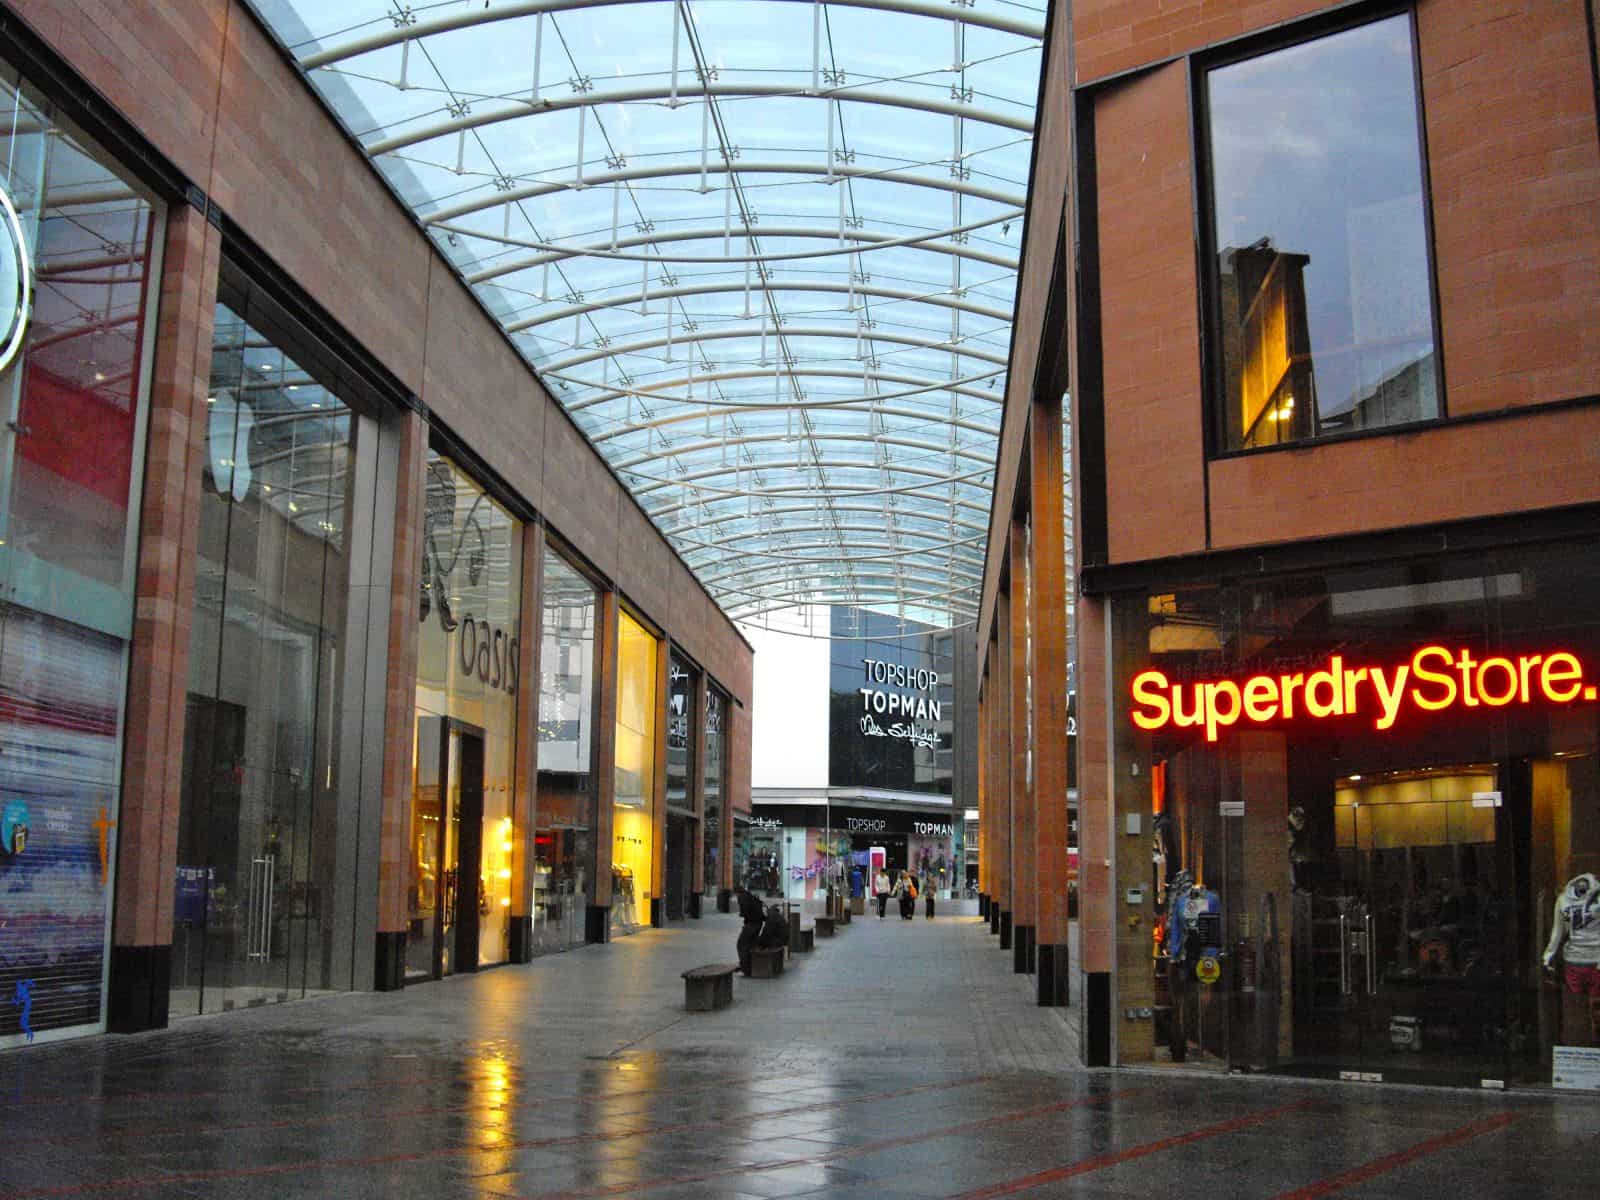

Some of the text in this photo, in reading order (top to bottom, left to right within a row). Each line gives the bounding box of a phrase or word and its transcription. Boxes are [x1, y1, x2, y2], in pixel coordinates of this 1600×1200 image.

[461, 613, 518, 696] oasis
[863, 658, 938, 692] TOPSHOP
[860, 688, 941, 721] TOPMAN
[887, 722, 942, 751] Selfridge
[846, 817, 887, 832] TOPSHOP
[914, 821, 954, 836] TOPMAN
